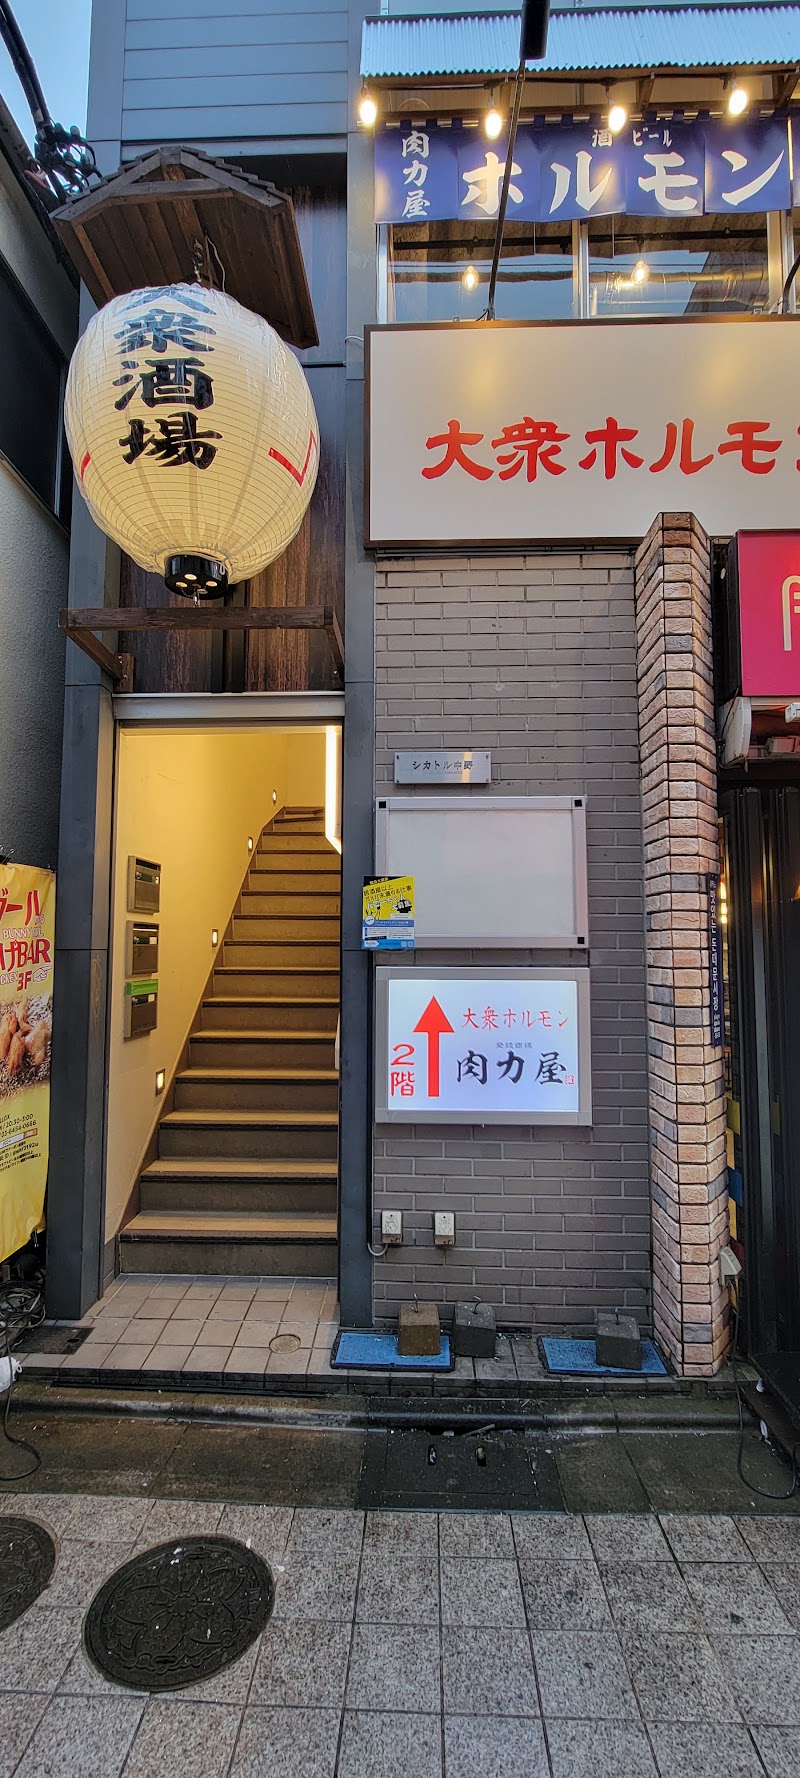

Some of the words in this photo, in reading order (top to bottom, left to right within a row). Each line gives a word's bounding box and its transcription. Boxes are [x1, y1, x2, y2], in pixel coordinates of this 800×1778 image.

[591, 128, 613, 148] 酒
[632, 127, 672, 148] ビール
[401, 130, 431, 219] 肉力屋
[460, 149, 785, 216] ホルモン
[112, 284, 223, 470] 大衆酒場
[420, 416, 800, 483] 大衆ホルモ
[460, 1005, 569, 1030] 大衆ホルモン
[390, 1043, 416, 1097] 2階
[456, 1050, 567, 1085] 肉力屋
